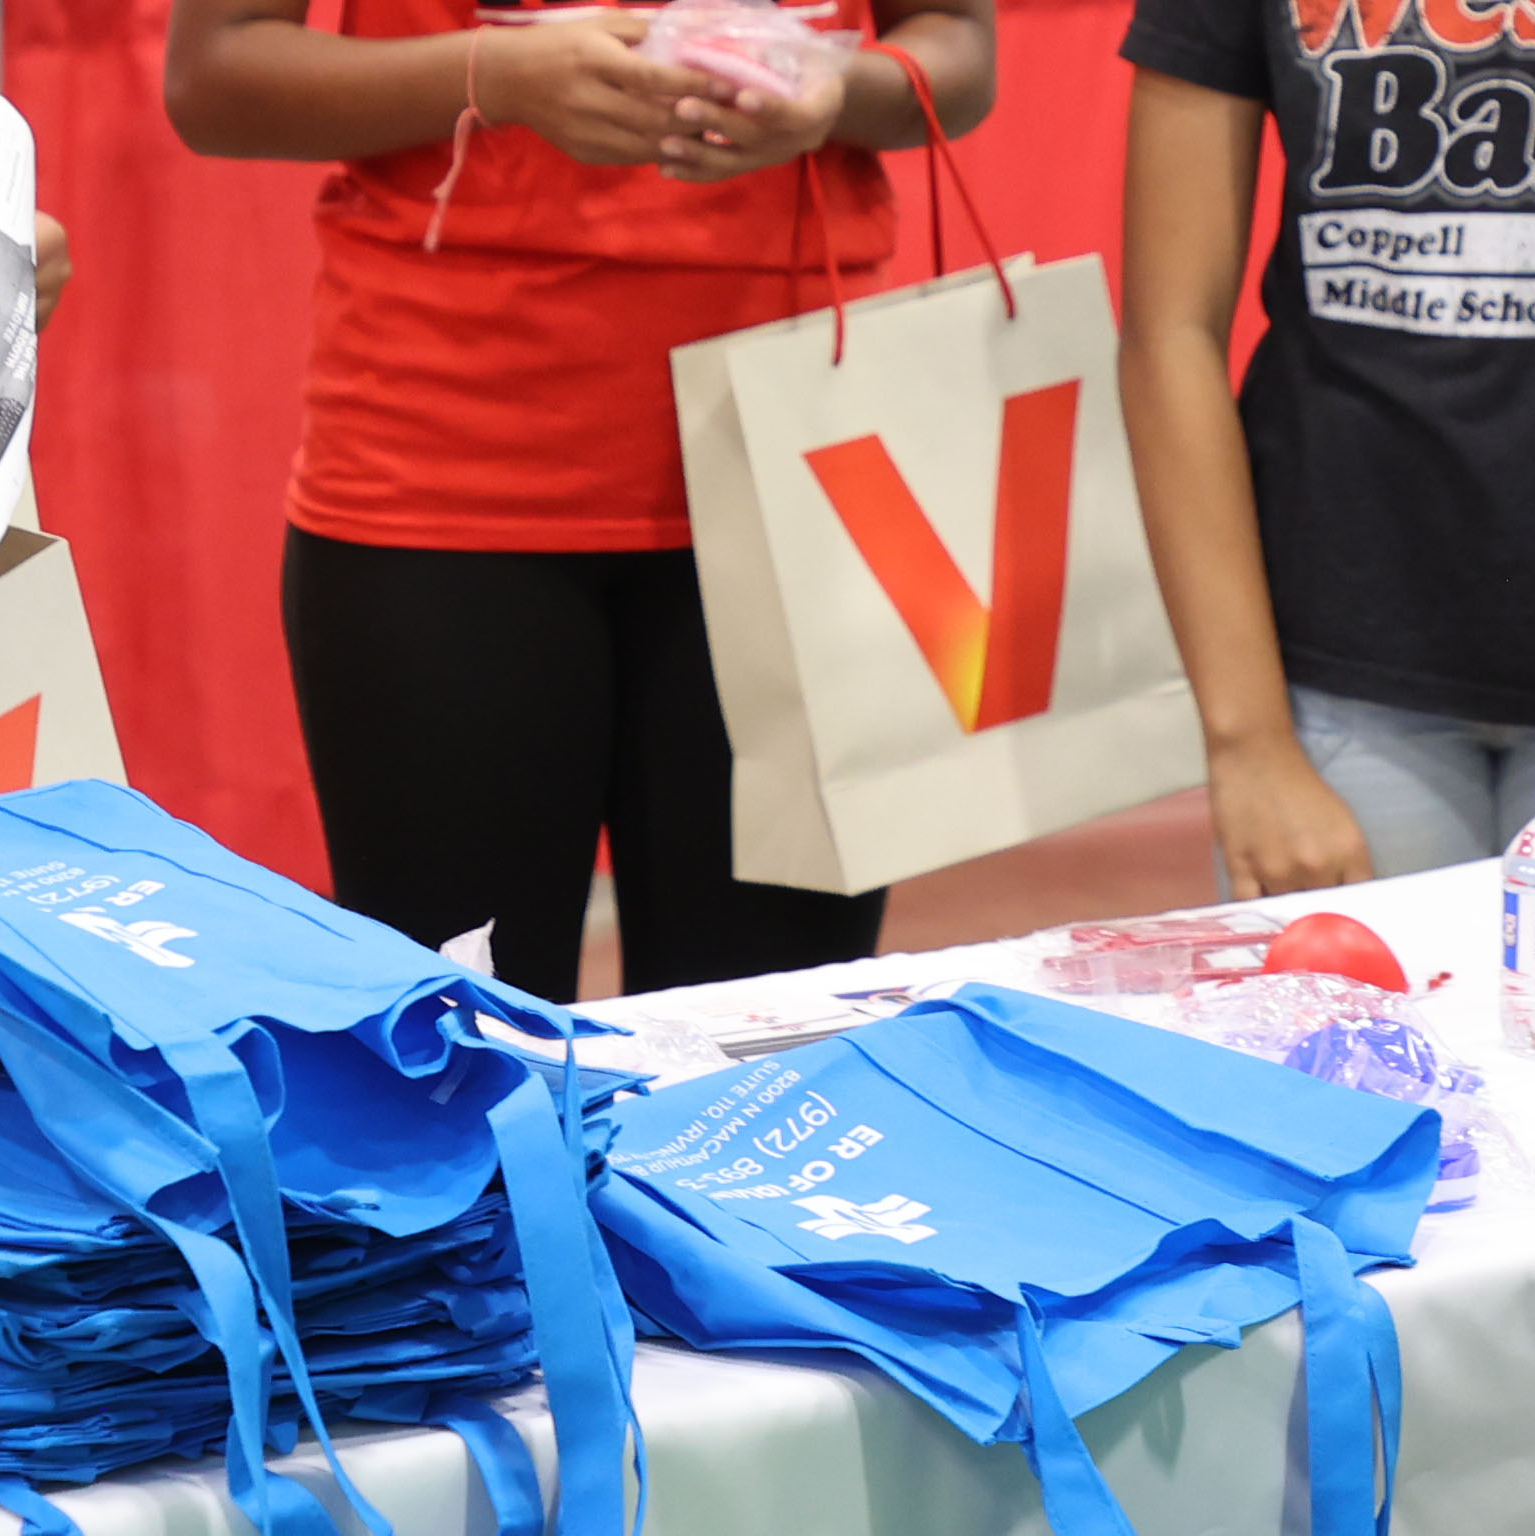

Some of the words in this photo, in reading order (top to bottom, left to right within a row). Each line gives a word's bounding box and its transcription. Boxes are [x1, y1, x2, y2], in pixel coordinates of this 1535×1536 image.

[1315, 220, 1466, 262] Coppell
[1321, 279, 1449, 323] Middle
[799, 376, 1082, 737] V
[729, 1060, 781, 1101] SUITE
[757, 1069, 802, 1105] 8200
[742, 1101, 764, 1121] N
[752, 1090, 838, 1159] (972)
[827, 1123, 885, 1161] ER
[786, 1159, 836, 1194] OF
